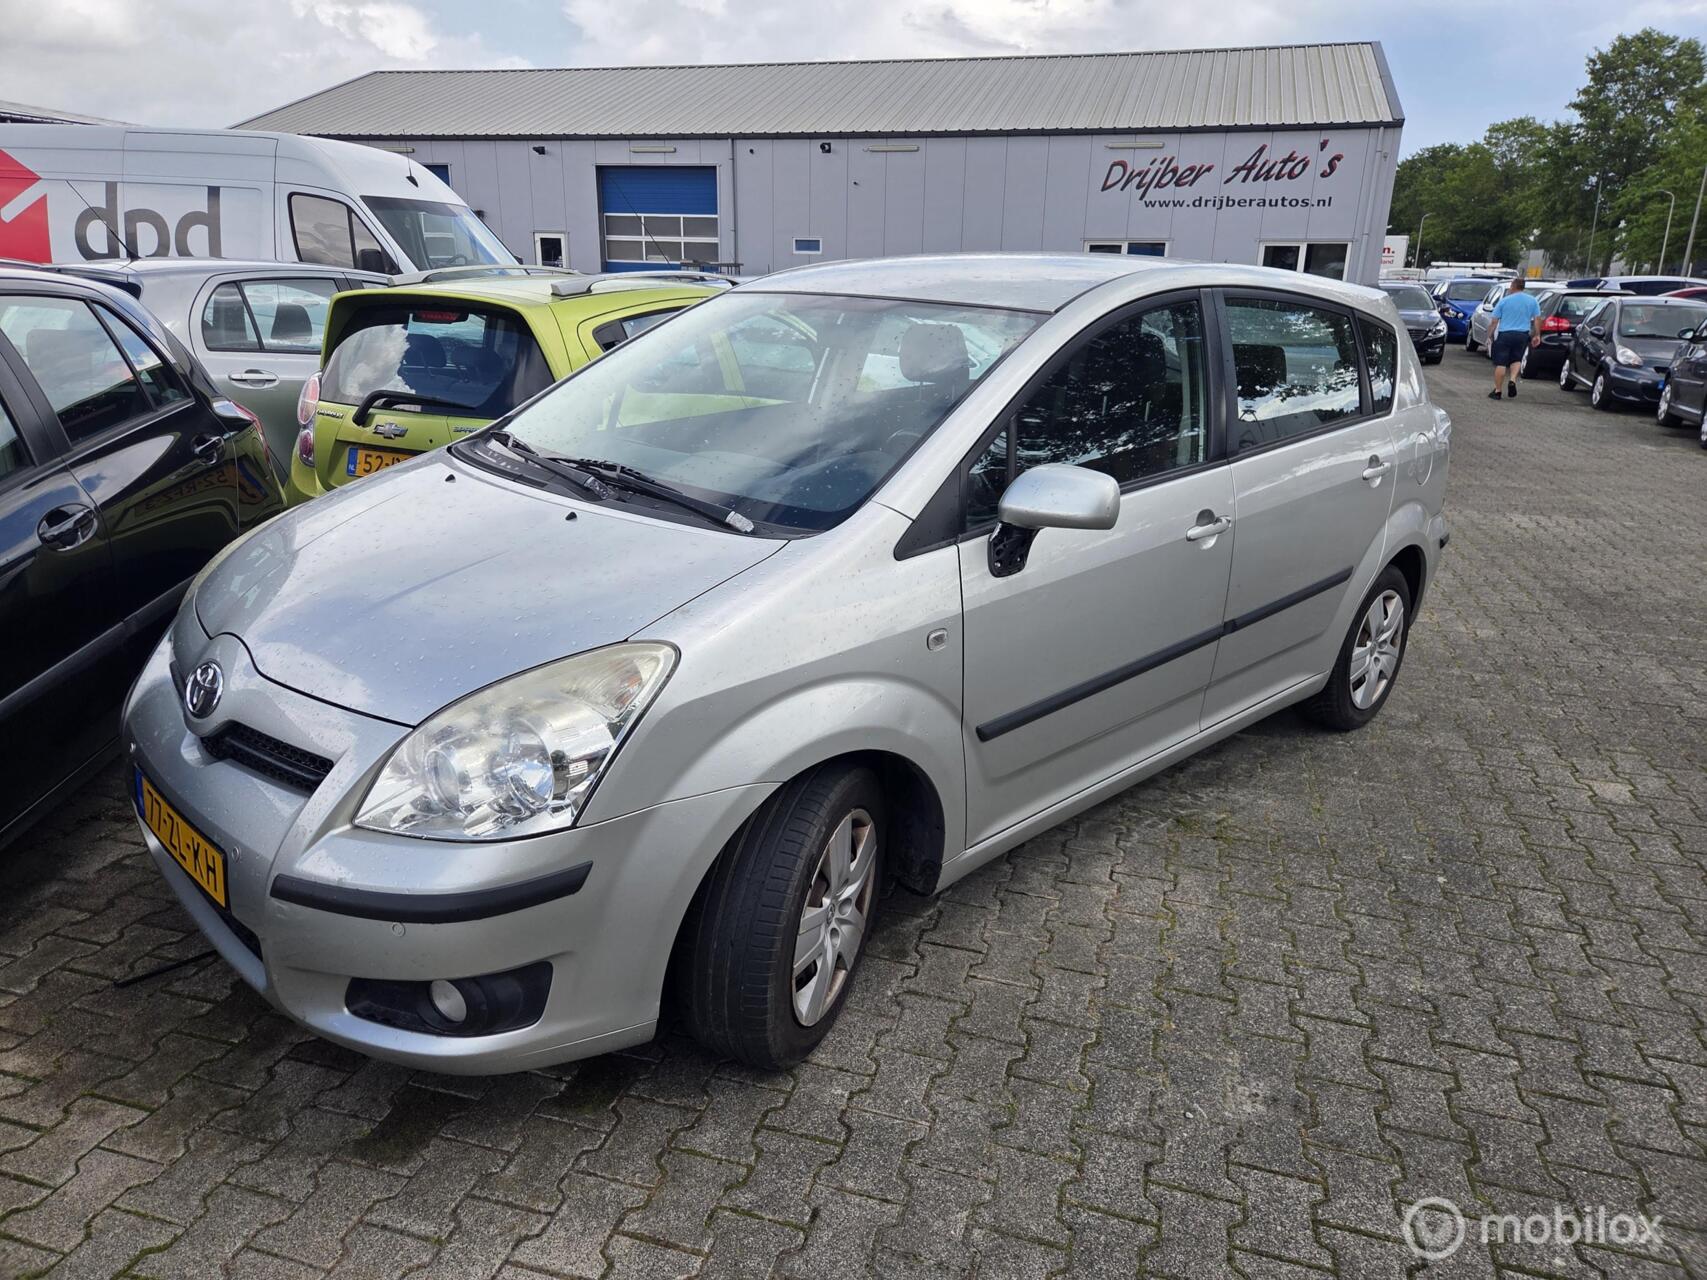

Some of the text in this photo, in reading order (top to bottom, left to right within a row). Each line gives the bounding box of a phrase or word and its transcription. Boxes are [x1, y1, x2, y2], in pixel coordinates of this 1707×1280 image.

[1100, 138, 1344, 201] Drijber Auto's
[1143, 195, 1333, 211] www.drijberautos.nl
[74, 181, 223, 261] dpd
[146, 787, 218, 893] 77-ZL-KH
